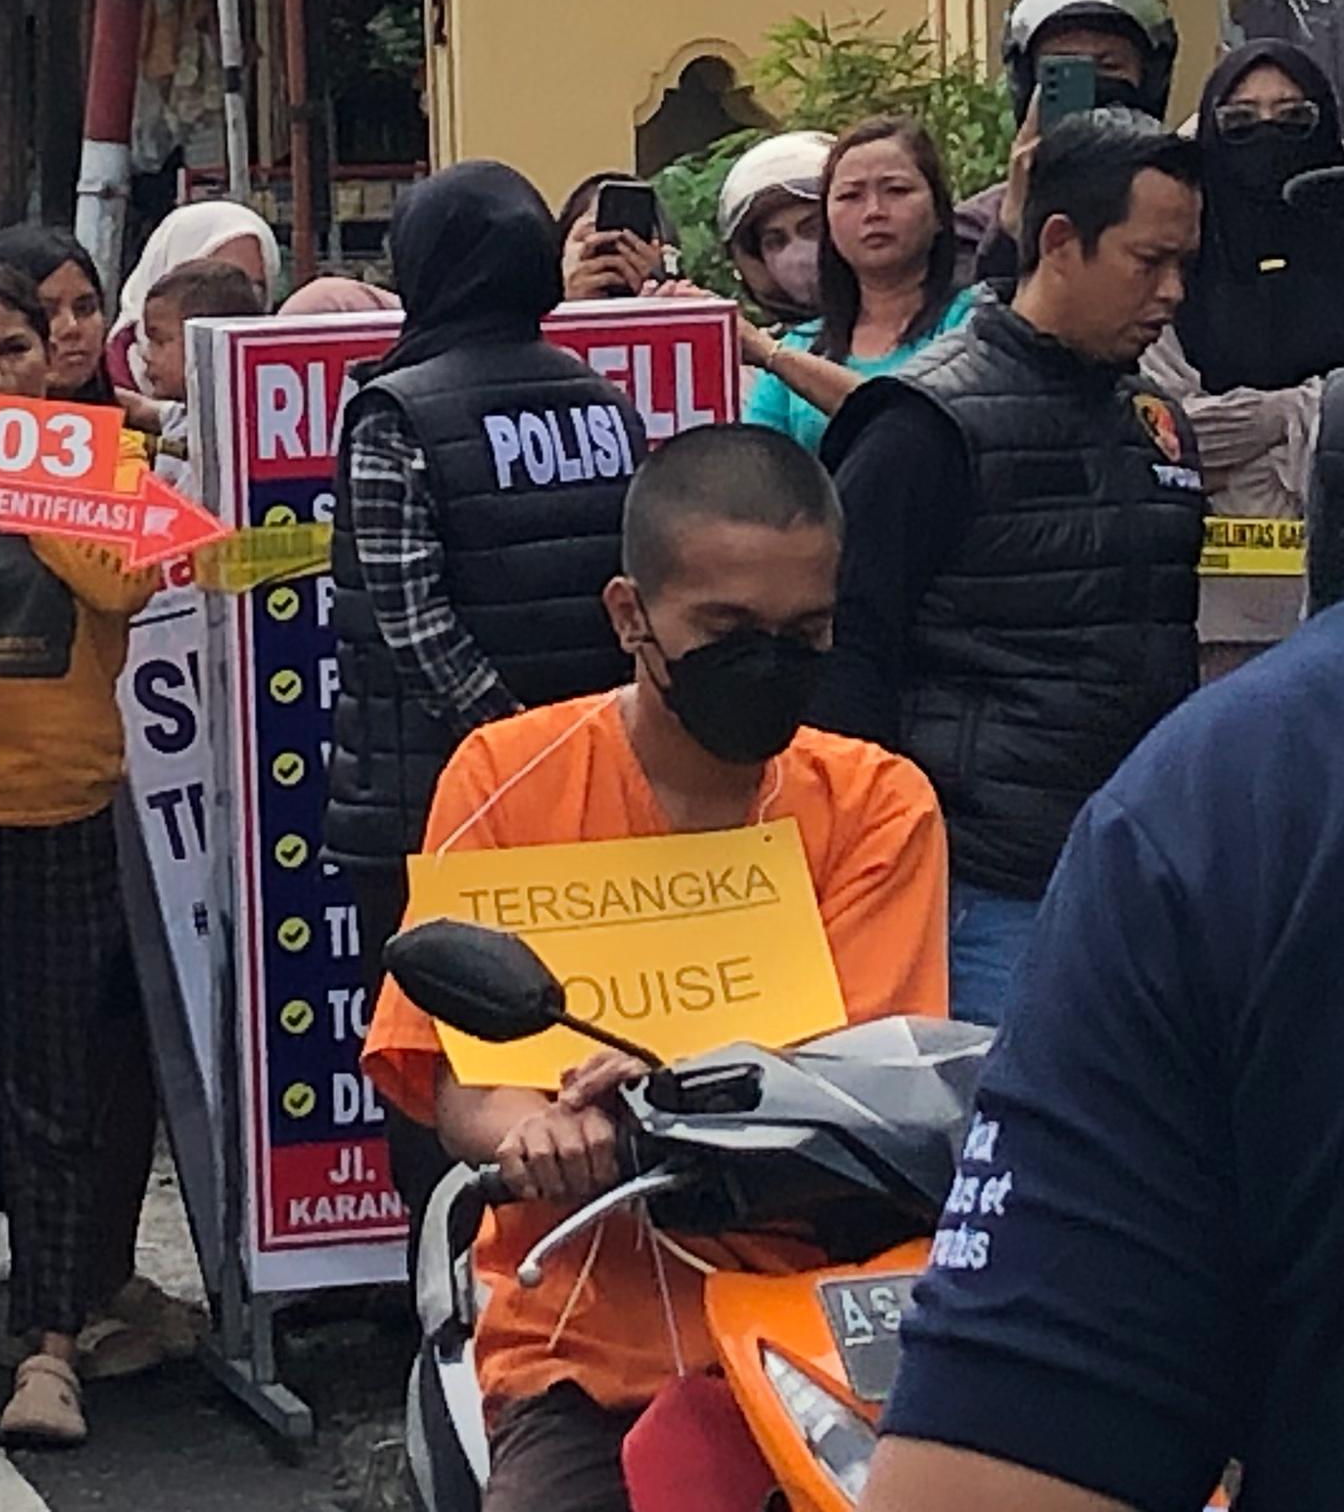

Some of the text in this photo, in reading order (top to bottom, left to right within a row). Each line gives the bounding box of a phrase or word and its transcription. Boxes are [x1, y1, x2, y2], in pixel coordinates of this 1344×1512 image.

[560, 342, 716, 439] ELL
[483, 404, 634, 489] POLISI
[459, 863, 778, 926] TERSANGKA
[563, 956, 762, 1023] OUISE
[288, 1191, 410, 1228] KARAN
